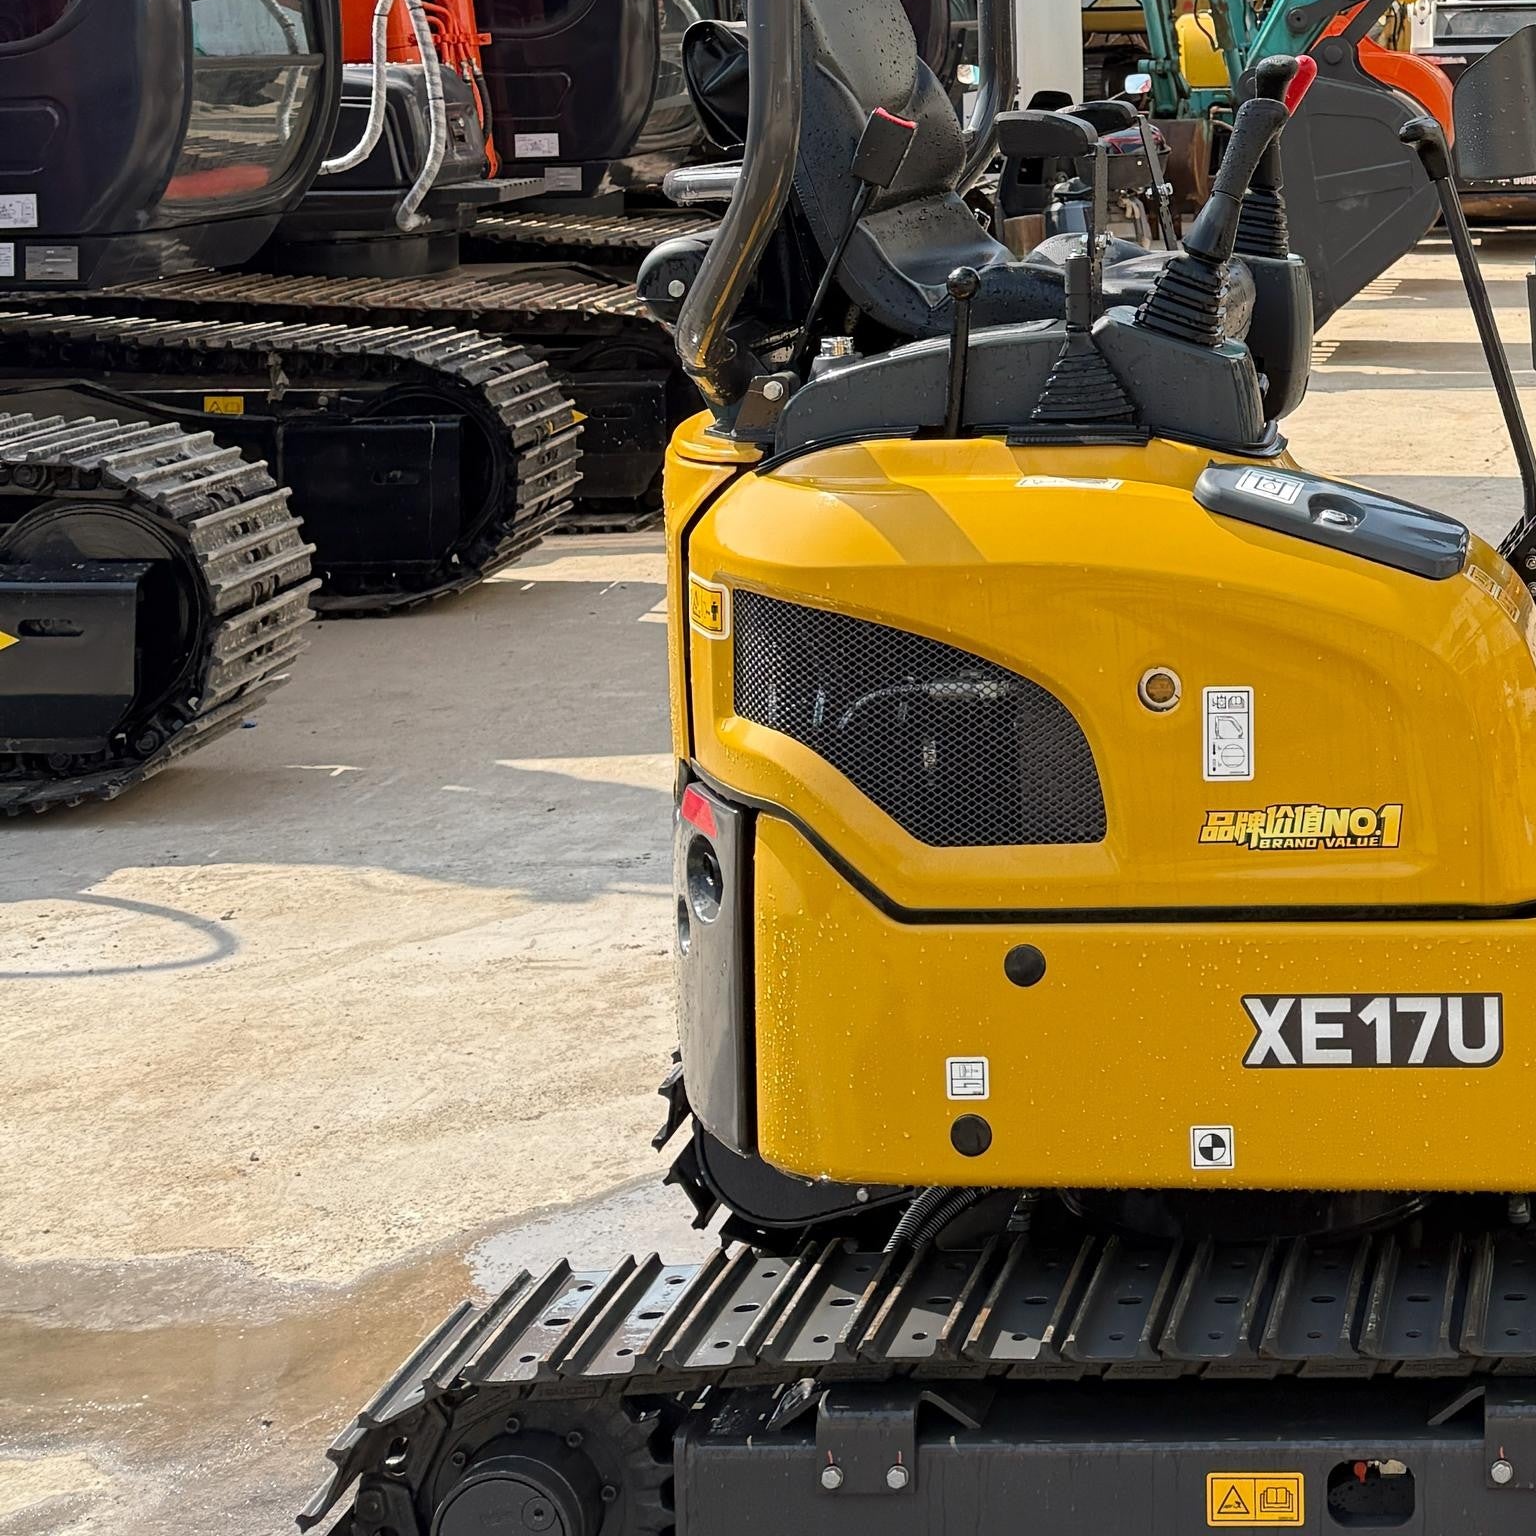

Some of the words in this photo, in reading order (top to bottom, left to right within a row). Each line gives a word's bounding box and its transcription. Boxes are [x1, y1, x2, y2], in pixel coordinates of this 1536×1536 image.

[1258, 837, 1318, 849] BRAND
[1325, 837, 1380, 848] VALUE
[1243, 996, 1501, 1065] XE17U
